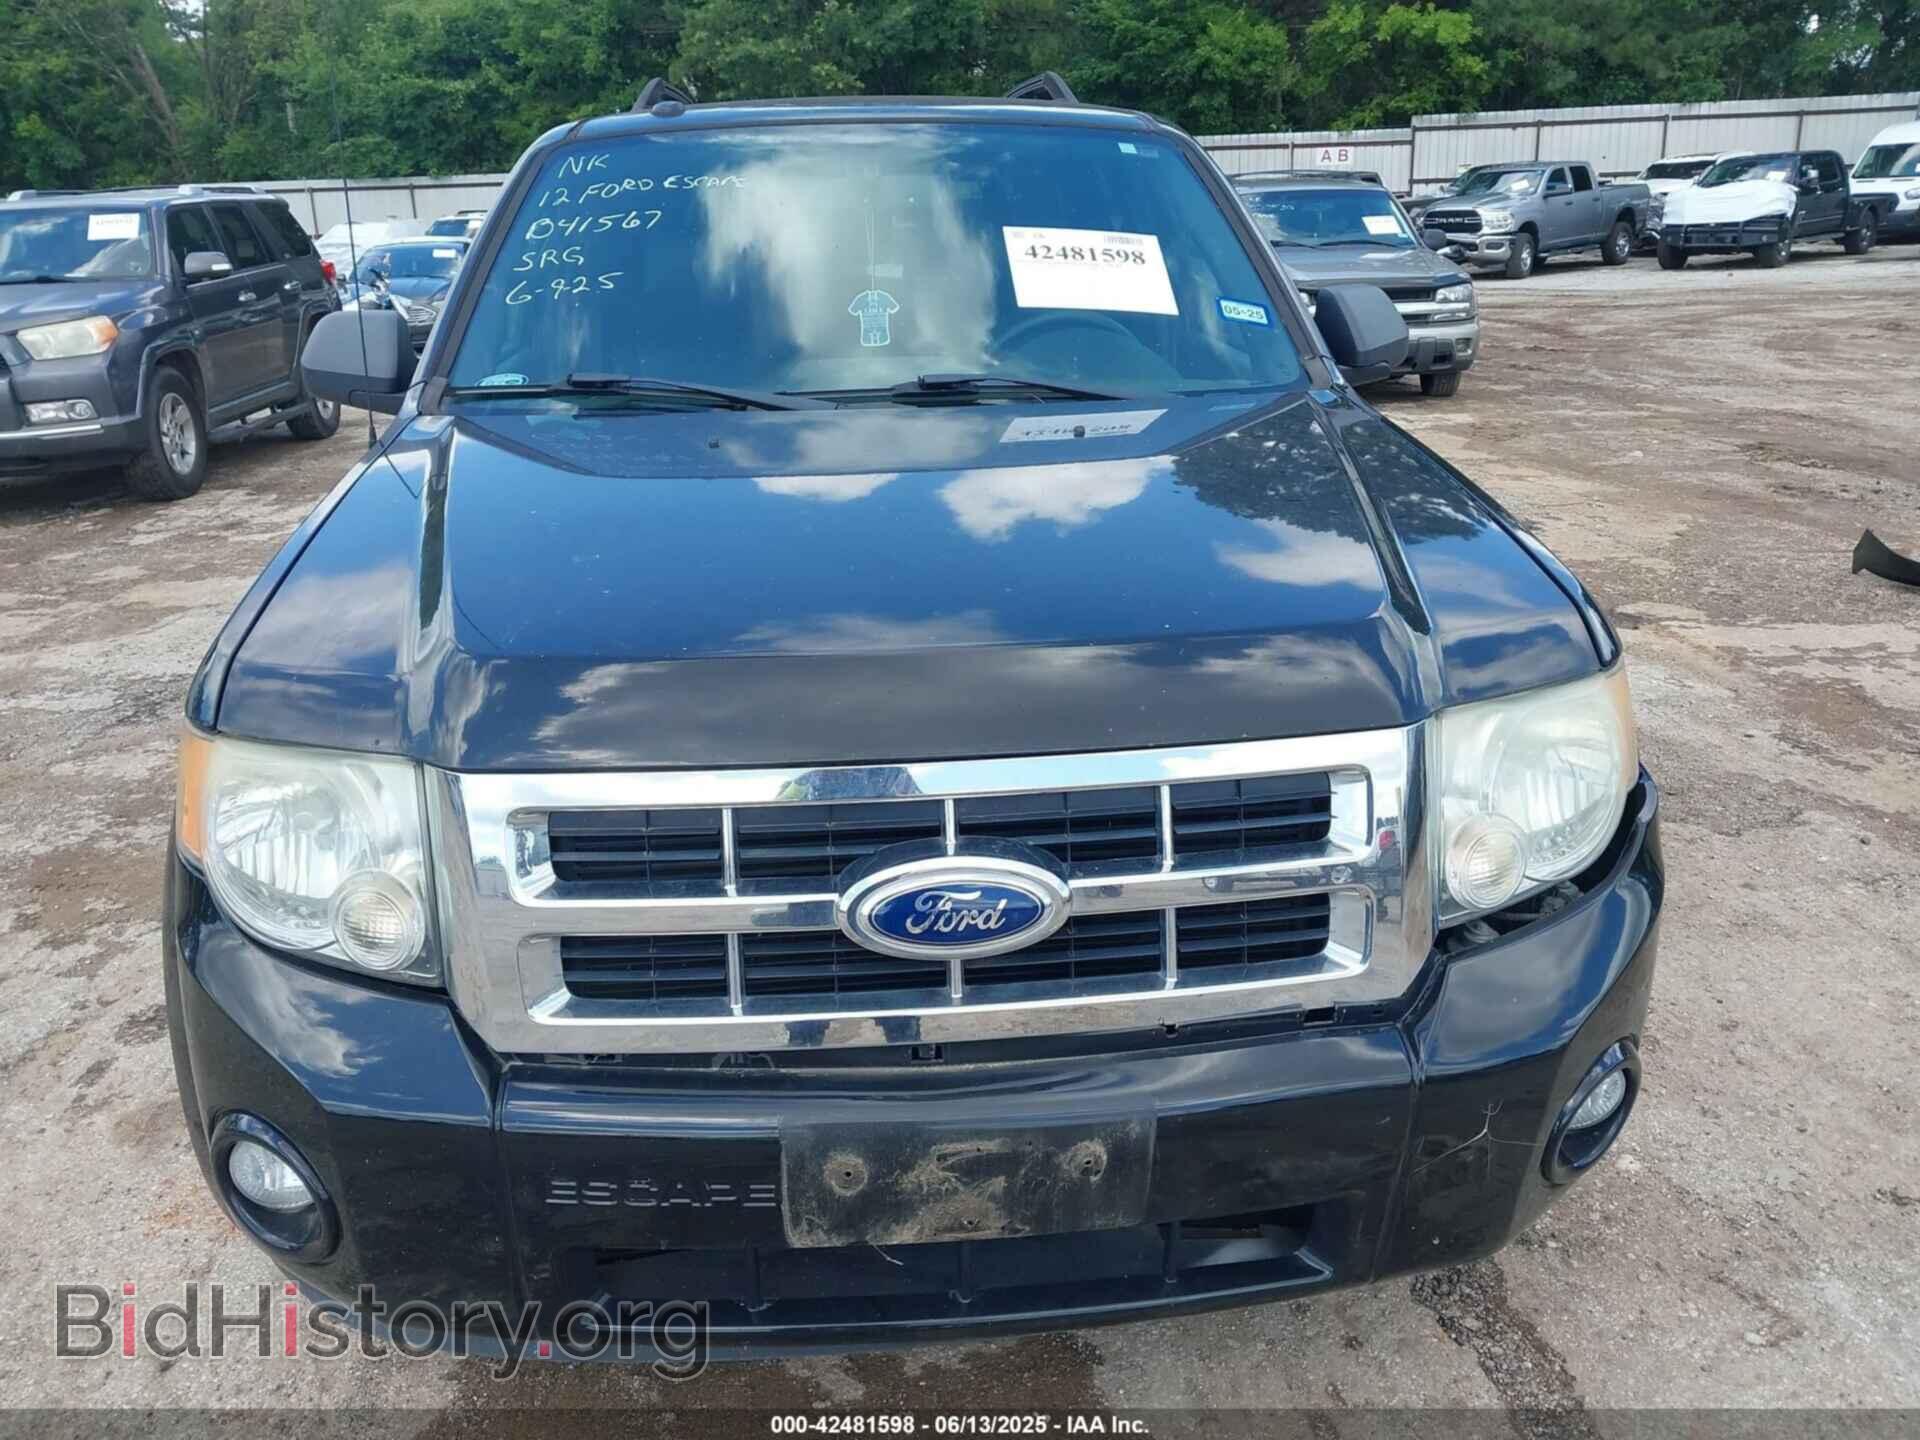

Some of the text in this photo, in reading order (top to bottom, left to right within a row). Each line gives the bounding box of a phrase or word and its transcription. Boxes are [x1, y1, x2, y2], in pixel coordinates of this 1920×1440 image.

[557, 154, 610, 178] NK
[538, 188, 570, 207] 12
[578, 179, 654, 204] FORD
[513, 246, 585, 271] SRG
[1024, 244, 1146, 265] 42481598
[1223, 304, 1265, 320] 05-25
[905, 890, 1007, 934] Ford
